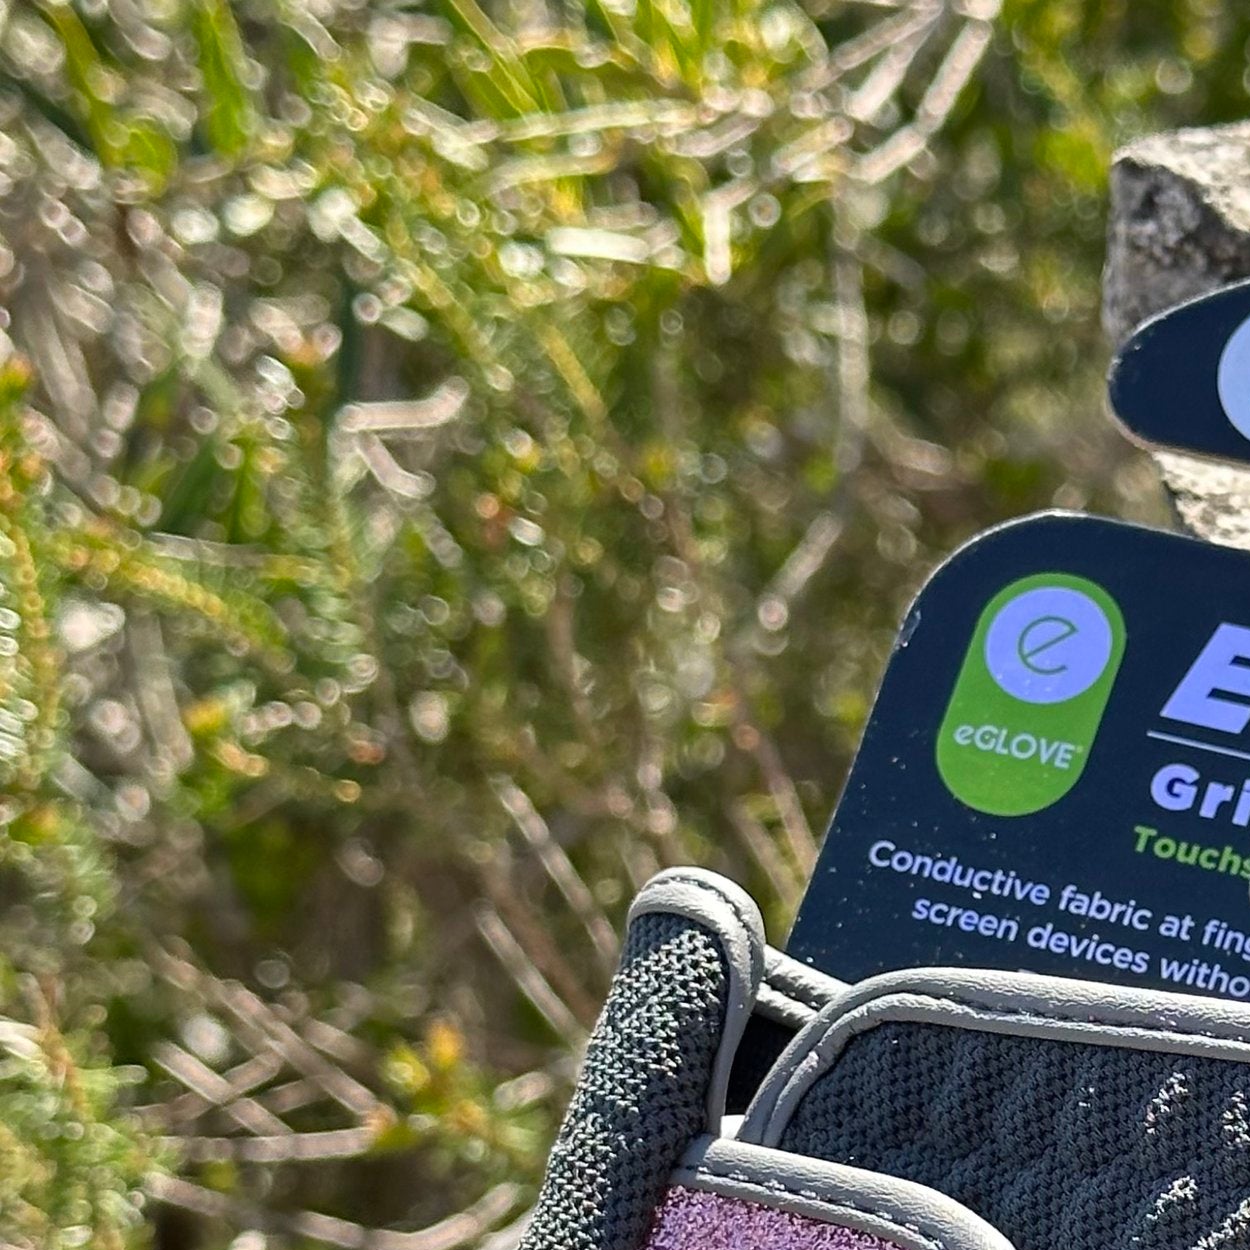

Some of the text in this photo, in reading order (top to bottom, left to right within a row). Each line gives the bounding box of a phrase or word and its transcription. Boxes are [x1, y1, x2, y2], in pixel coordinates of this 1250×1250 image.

[1017, 615, 1079, 675] e
[953, 724, 1076, 770] eGLOVE
[868, 839, 1051, 906] Conductive
[1058, 884, 1153, 931] fabric
[1158, 914, 1196, 941] at
[912, 898, 1019, 942] screen
[1027, 922, 1151, 974] devices
